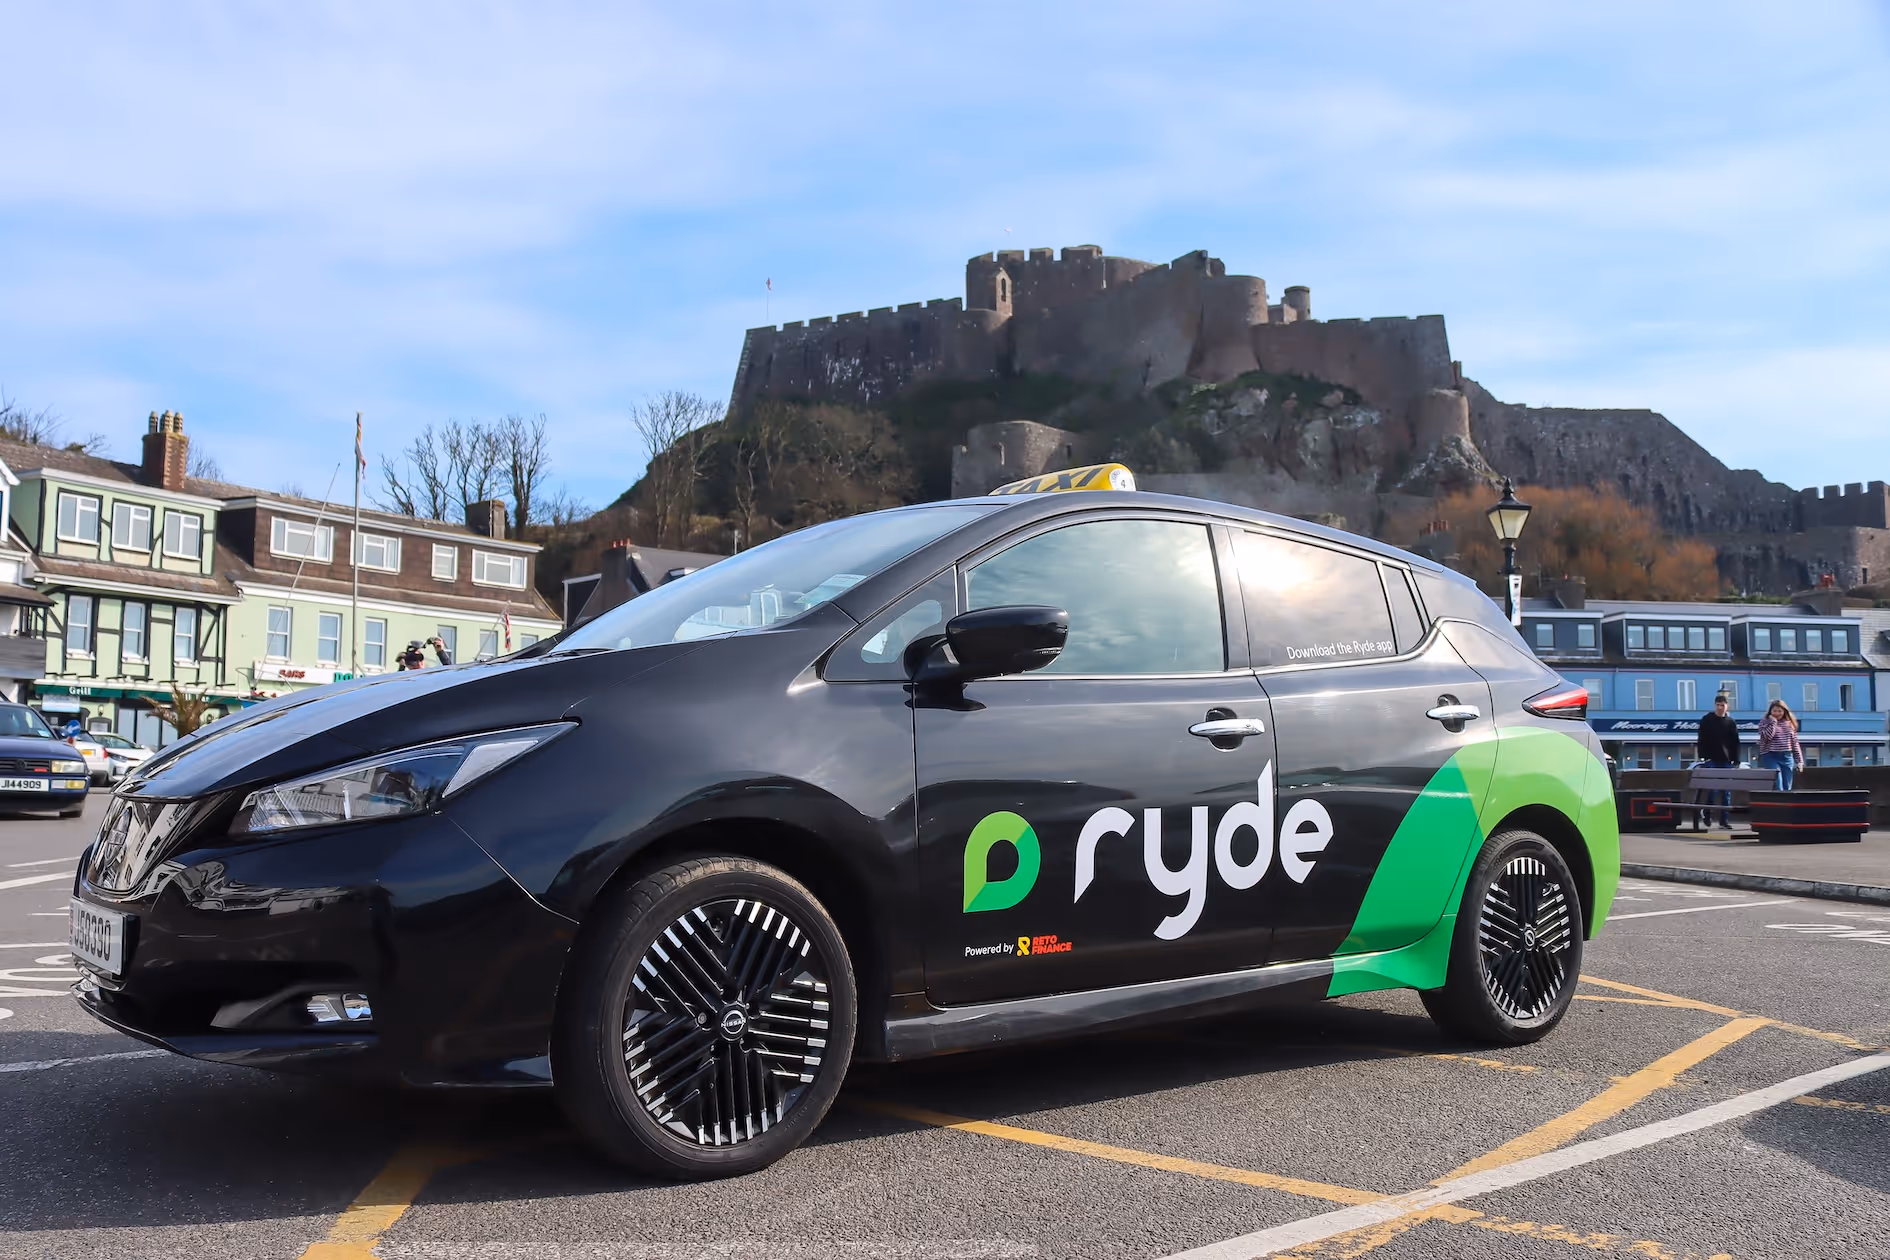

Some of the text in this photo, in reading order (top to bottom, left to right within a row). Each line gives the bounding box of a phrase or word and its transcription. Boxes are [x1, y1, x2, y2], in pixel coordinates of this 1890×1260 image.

[998, 467, 1104, 495] TAXI
[1286, 640, 1393, 659] Download the Ryde app
[69, 686, 91, 696] Grill
[1610, 720, 1700, 732] Moorings Hote
[1074, 758, 1334, 941] ryde
[1032, 935, 1057, 946] RETO
[964, 943, 1014, 957] Powered by
[1032, 942, 1072, 955] FINANCE
[721, 1017, 746, 1028] NISSAN
